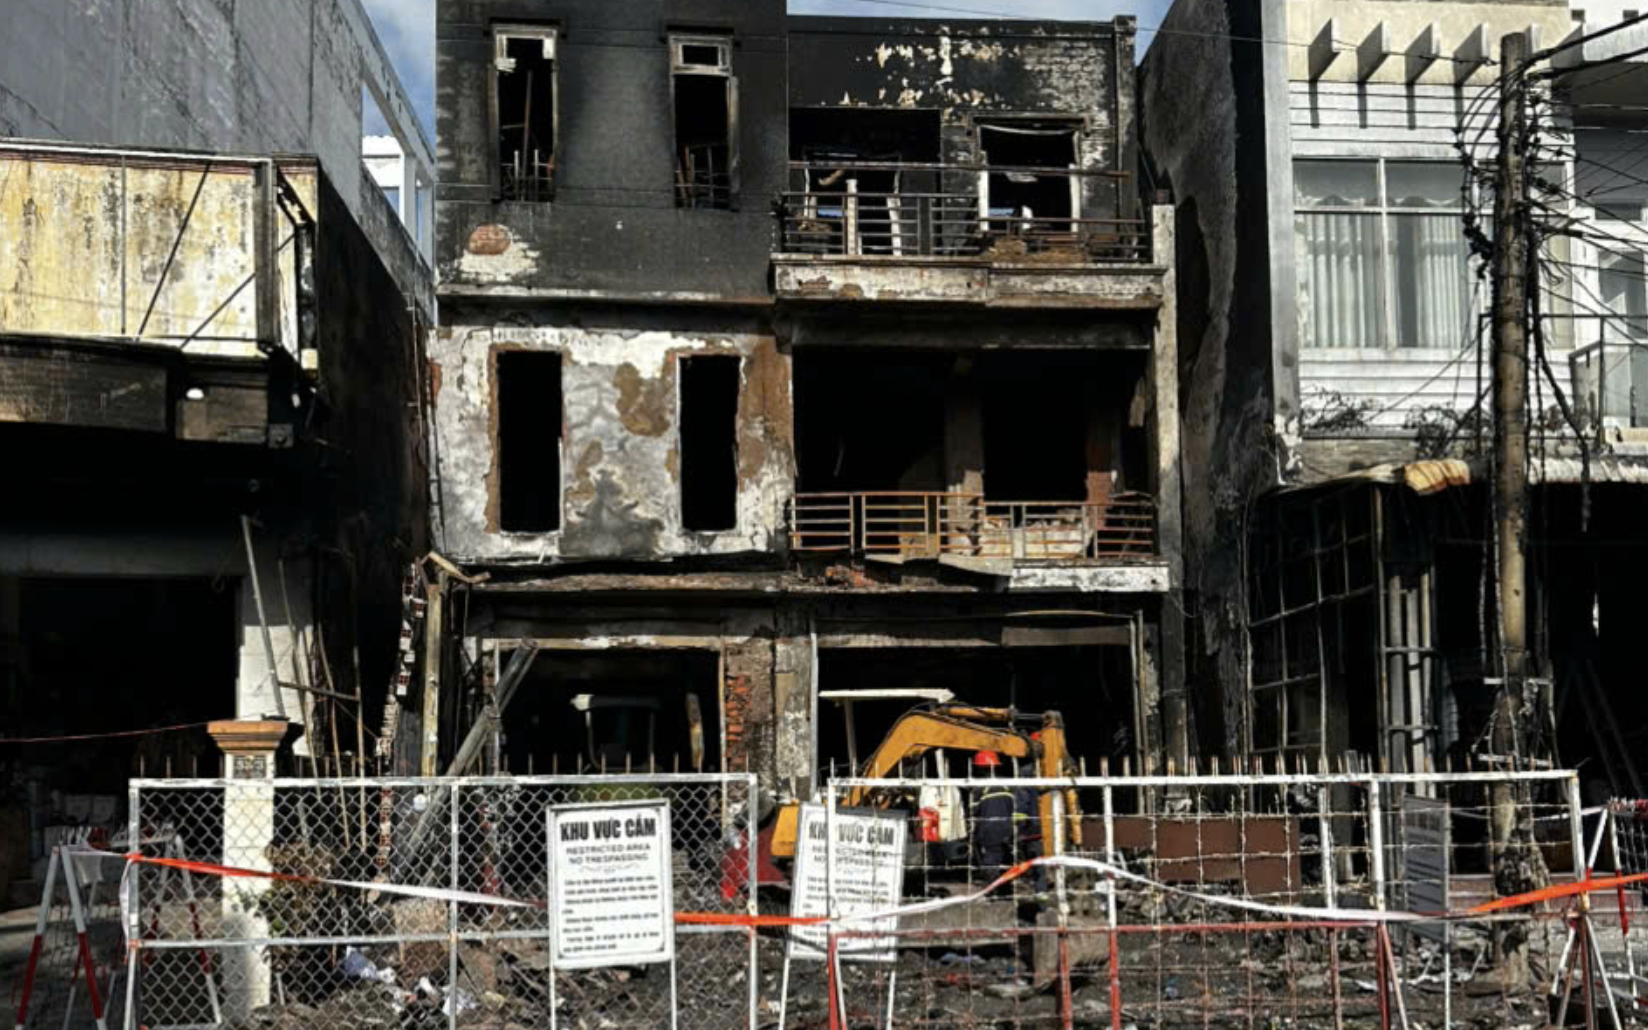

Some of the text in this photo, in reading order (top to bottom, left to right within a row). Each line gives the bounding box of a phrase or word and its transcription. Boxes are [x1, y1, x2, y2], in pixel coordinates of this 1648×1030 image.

[560, 821, 589, 842] KHU
[592, 817, 621, 843] VỰC
[809, 821, 828, 840] KH
[566, 843, 651, 854] RESTRICTED AREA
[568, 852, 649, 864] NO TRESPASSING
